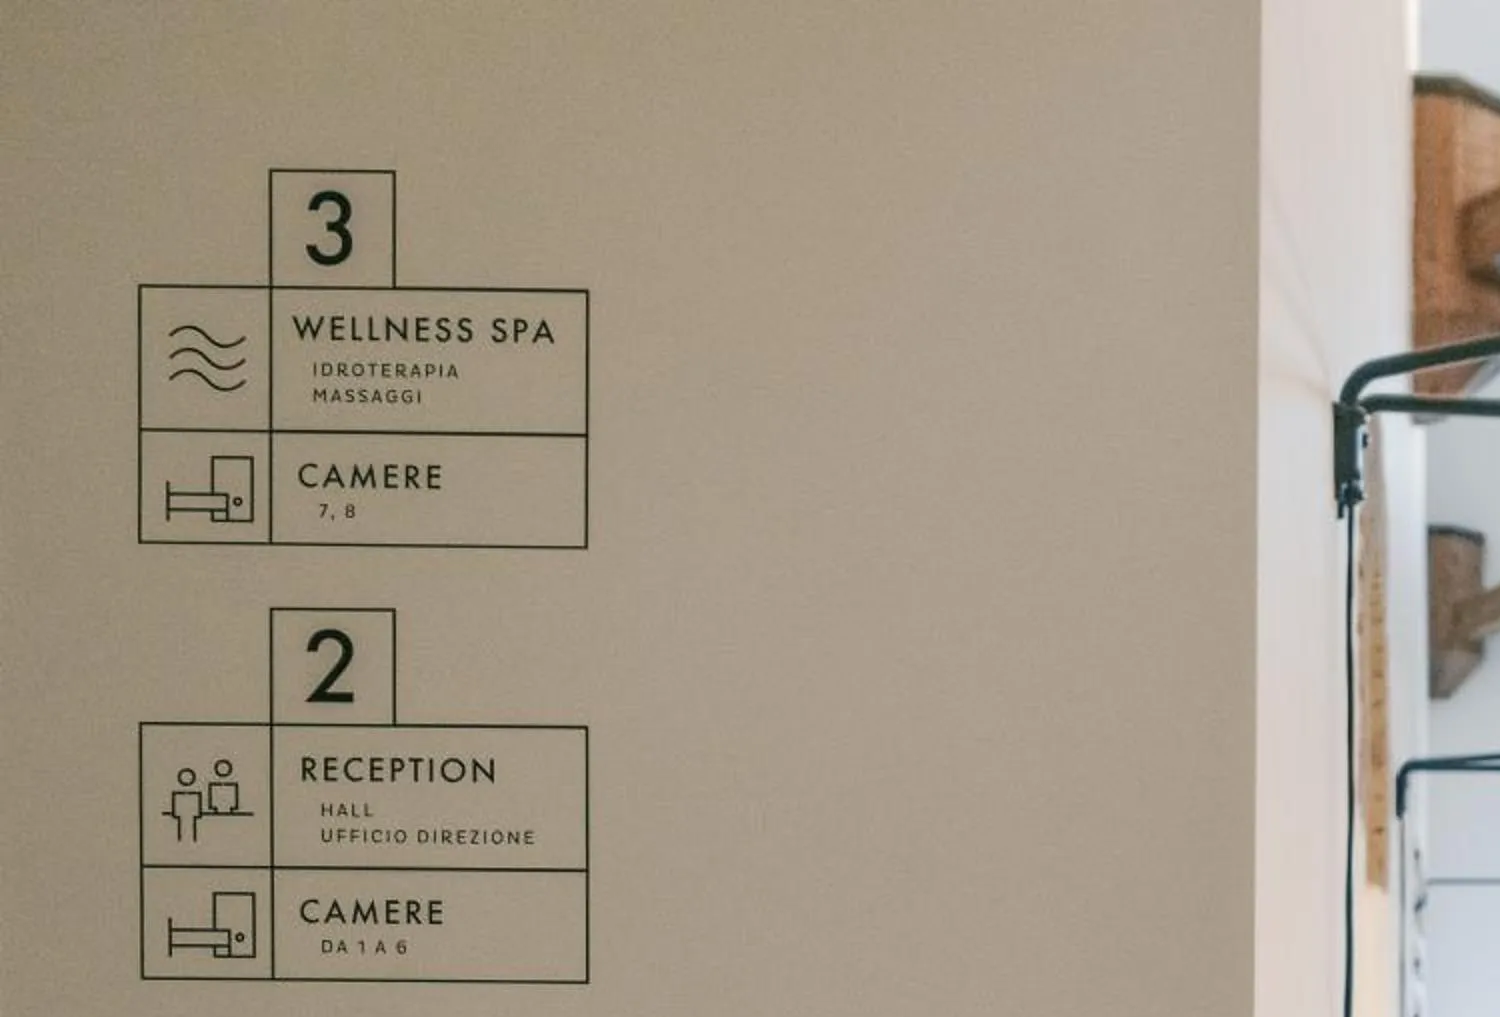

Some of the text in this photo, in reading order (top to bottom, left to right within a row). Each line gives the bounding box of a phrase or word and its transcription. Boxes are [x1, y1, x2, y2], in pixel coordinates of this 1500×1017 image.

[306, 190, 352, 266] 3
[292, 316, 554, 344] WELLNESS SPA
[314, 362, 458, 378] IDROTERAPIA
[313, 389, 420, 403] MASSAGGI
[298, 463, 441, 489] CAMERE
[320, 504, 355, 520] 7, 8
[305, 629, 354, 703] 2
[302, 757, 494, 783] RECEPTION
[321, 803, 374, 818] HALL
[321, 828, 534, 845] UFFICIO DIREZIONE
[300, 899, 443, 924] CAMERE
[321, 939, 407, 955] DA 1 A 6
